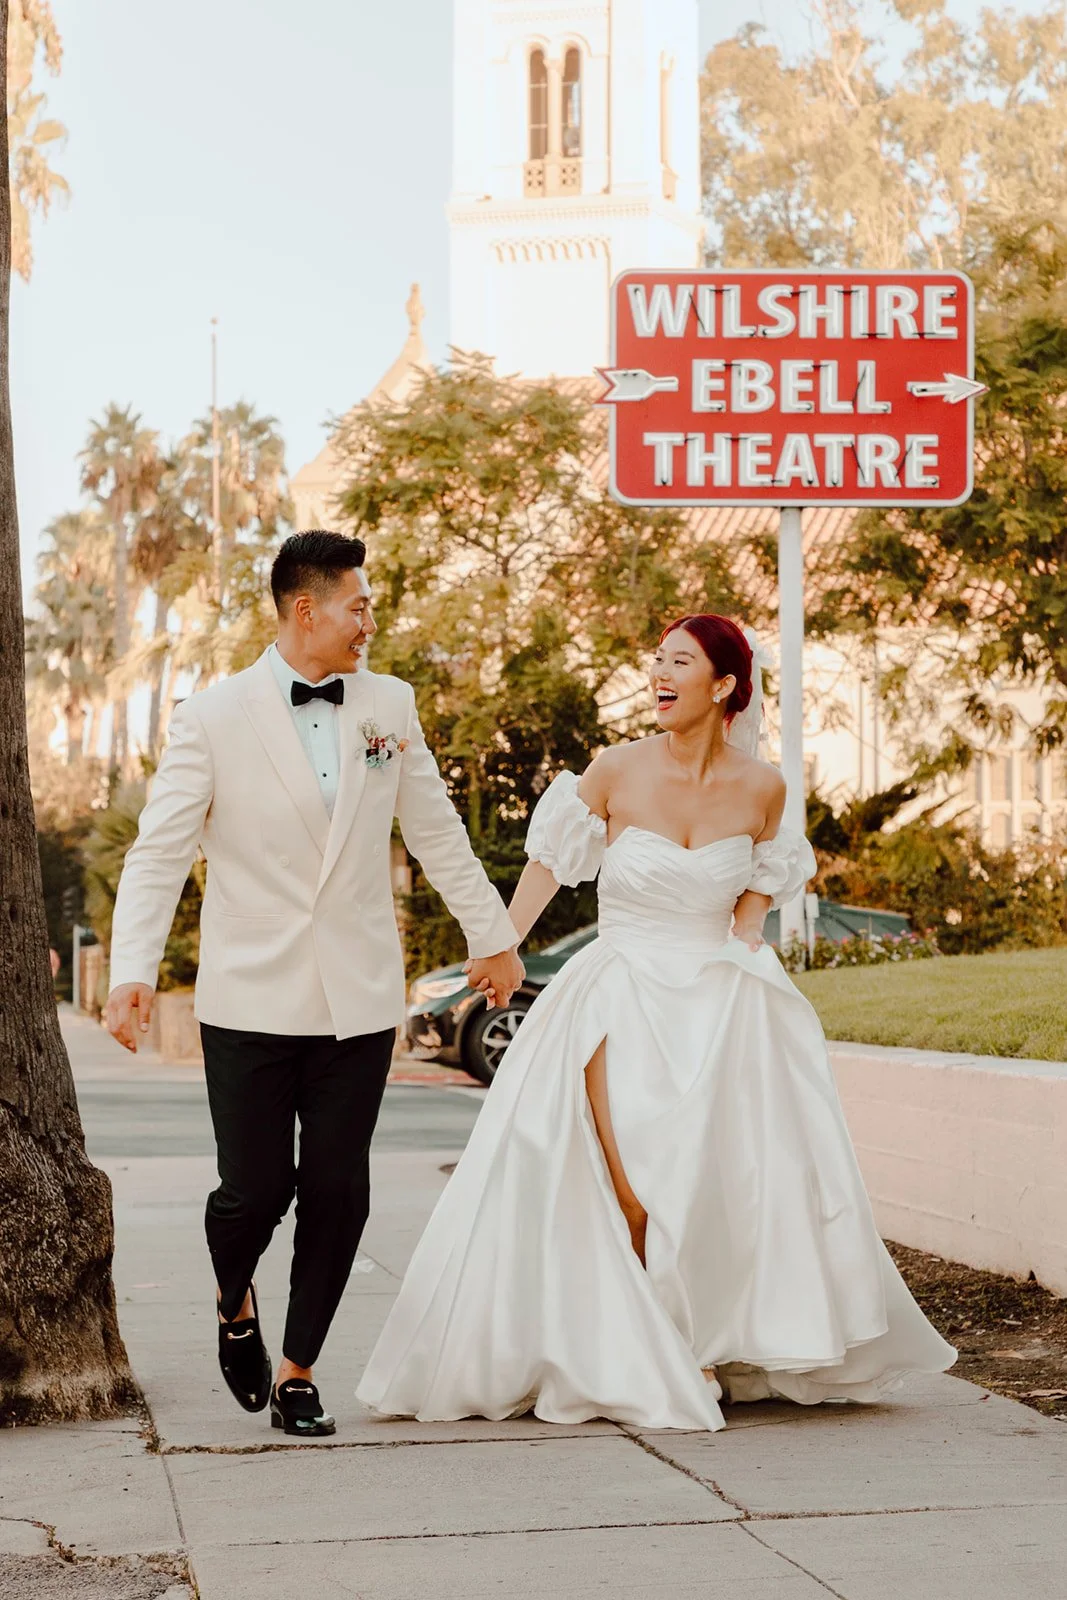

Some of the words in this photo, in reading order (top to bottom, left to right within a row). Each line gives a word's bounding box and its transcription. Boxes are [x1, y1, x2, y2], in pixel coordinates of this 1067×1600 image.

[626, 284, 959, 339] WILSHIRE
[691, 358, 892, 414] EBELL
[643, 432, 940, 488] THEATRE
